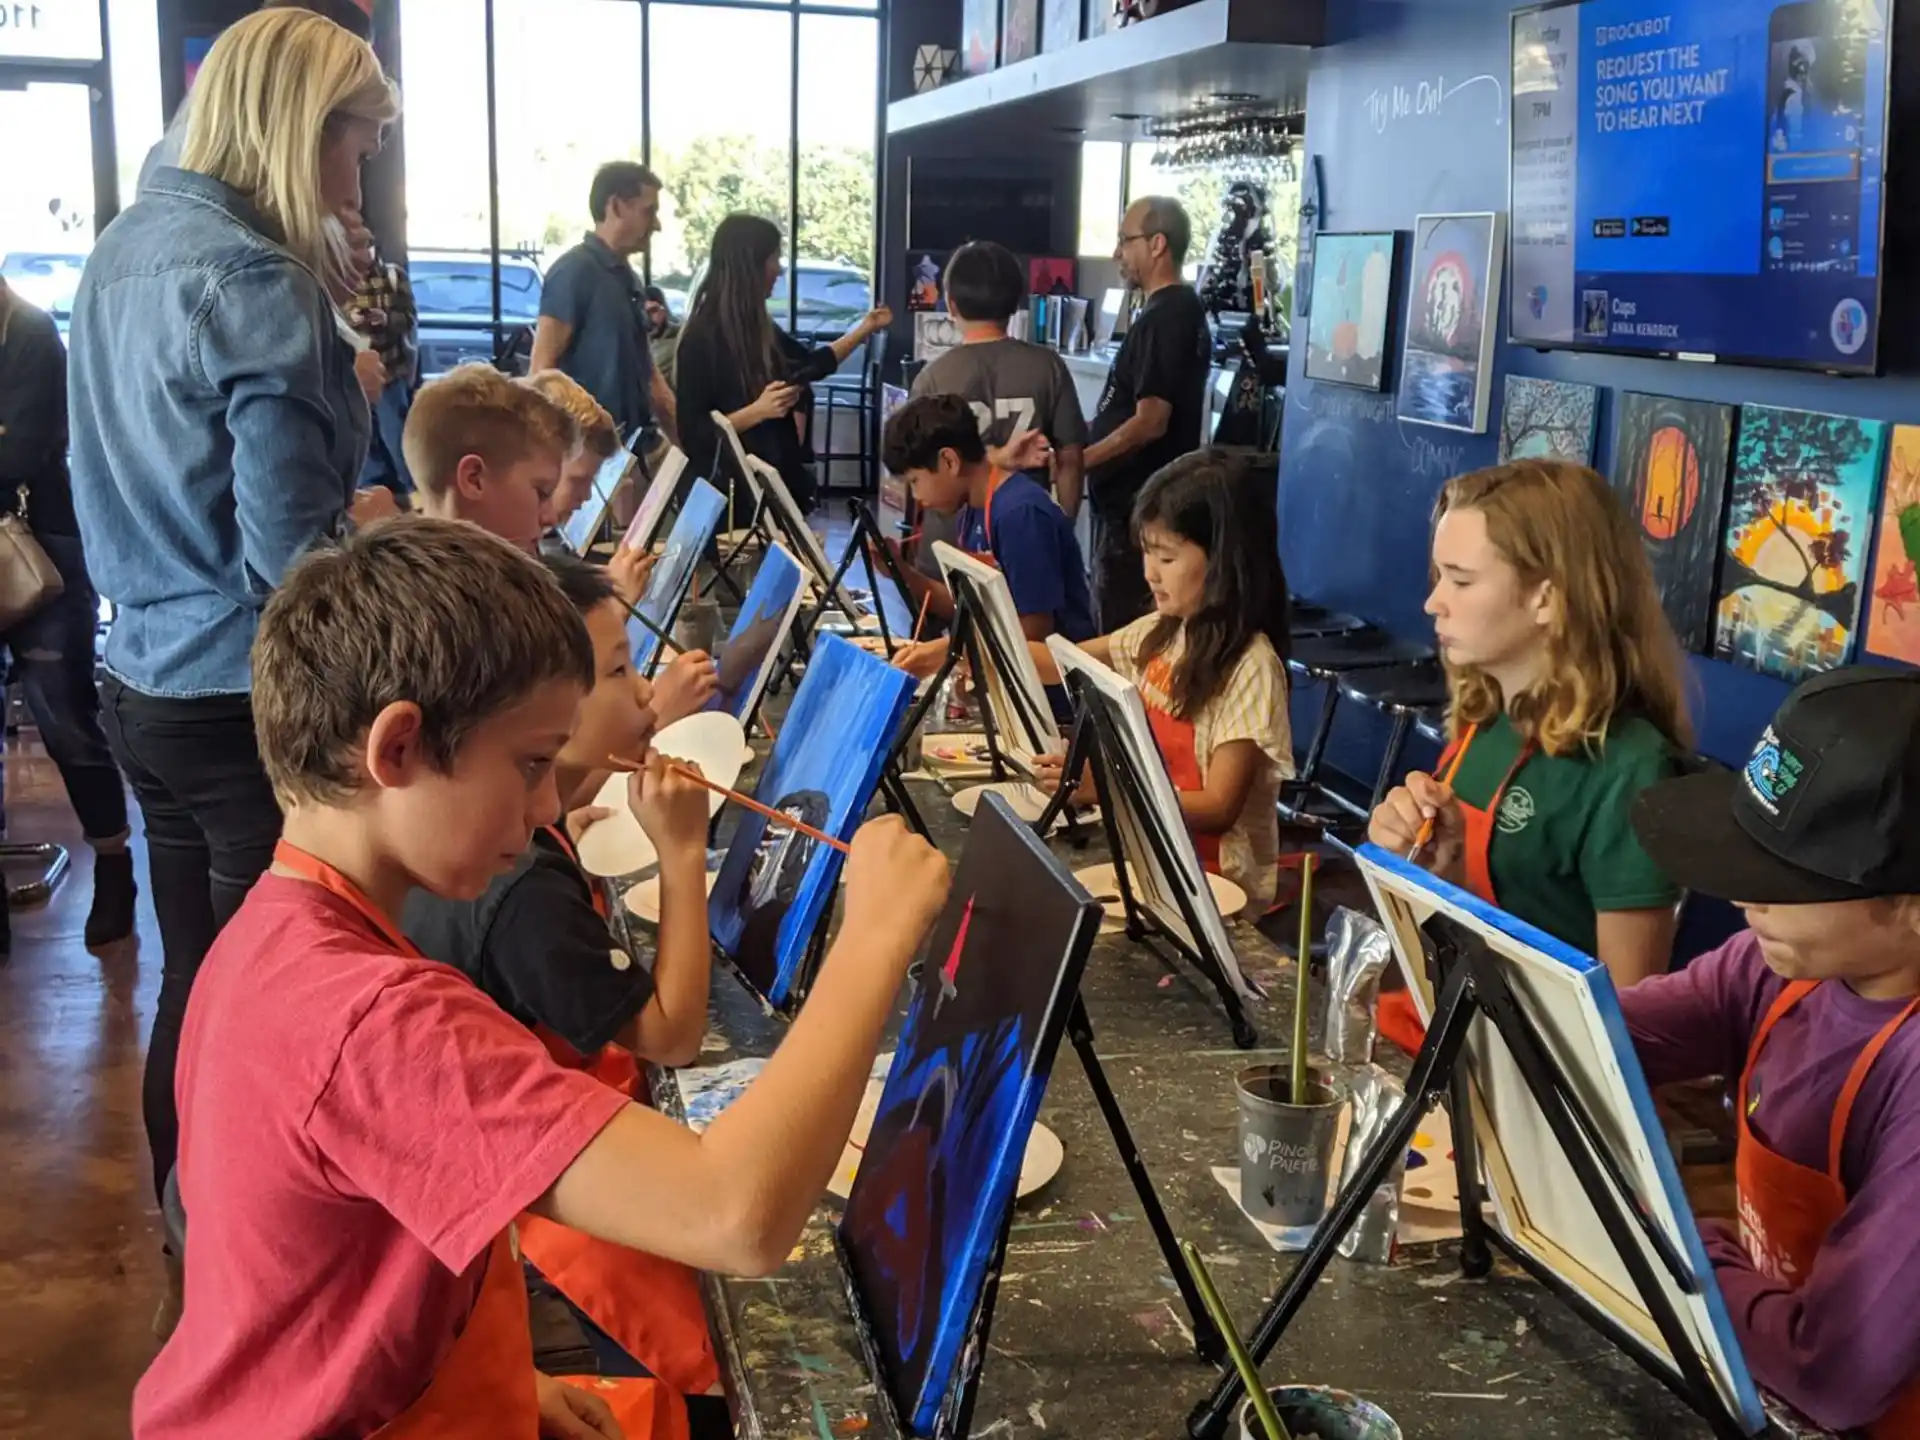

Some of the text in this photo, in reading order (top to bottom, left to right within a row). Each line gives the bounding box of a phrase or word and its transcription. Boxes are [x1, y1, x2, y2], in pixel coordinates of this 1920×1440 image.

[1609, 16, 1671, 42] ROCKBOT
[1597, 49, 1665, 81] REQUEST
[1668, 43, 1700, 70] THE
[1596, 68, 1729, 107] SONG YOU WANT
[1363, 89, 1388, 135] Try
[1392, 85, 1411, 120] Me
[1595, 99, 1705, 133] TO HEAR NEXT
[1612, 298, 1637, 319] Cups
[1612, 321, 1679, 338] ANNA KENDRICK
